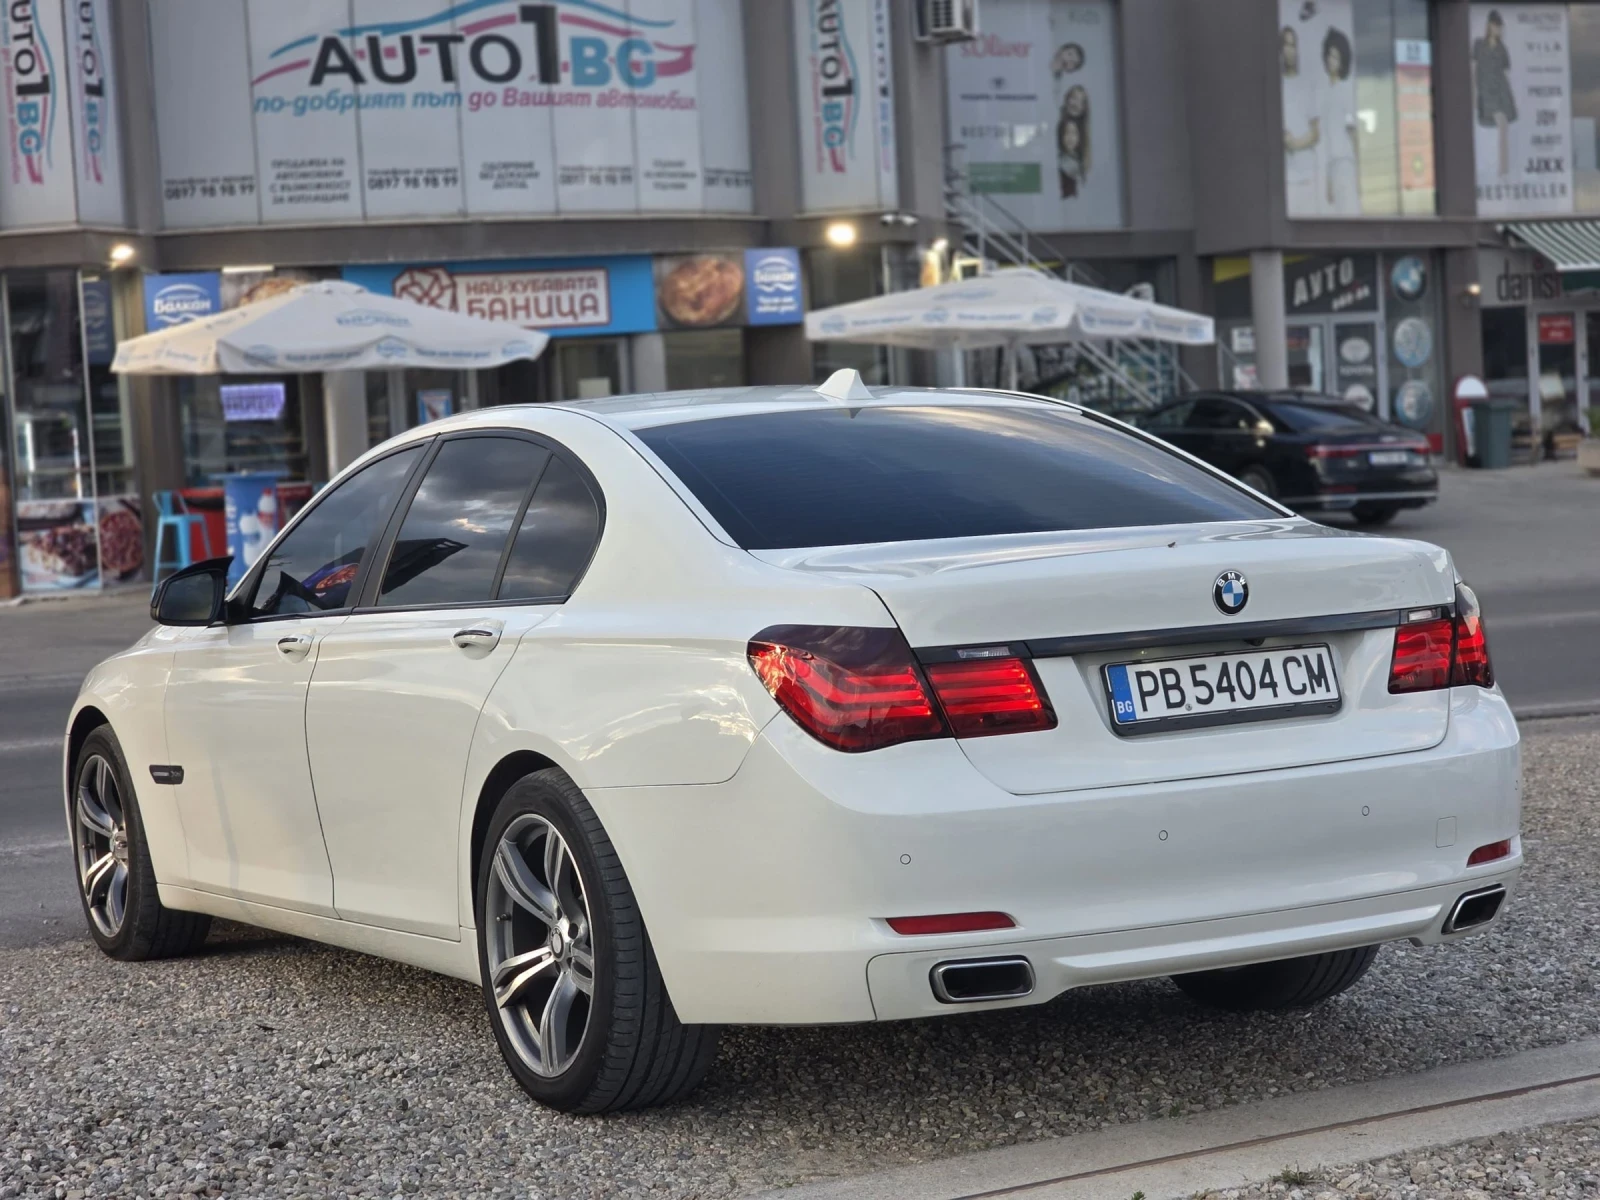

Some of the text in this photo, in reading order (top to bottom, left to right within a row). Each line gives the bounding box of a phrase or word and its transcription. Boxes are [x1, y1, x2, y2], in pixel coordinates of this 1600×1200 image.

[309, 5, 656, 88] AUTO1BG
[255, 88, 407, 116] по-добрият
[411, 92, 462, 108] път
[468, 91, 497, 112] до
[503, 87, 592, 107] Вашият
[1525, 157, 1564, 174] JJXX
[164, 185, 197, 200] 0897
[201, 184, 217, 198] 98
[219, 183, 237, 197] 98
[1476, 183, 1567, 200] BESTSELLER
[465, 275, 598, 295] НАЙ-ХУБАВАТА
[467, 293, 600, 321] БАНИЦА
[1217, 572, 1246, 588] BMW
[1189, 658, 1279, 705] 5404
[1282, 653, 1331, 696] CM
[1117, 700, 1133, 714] BG
